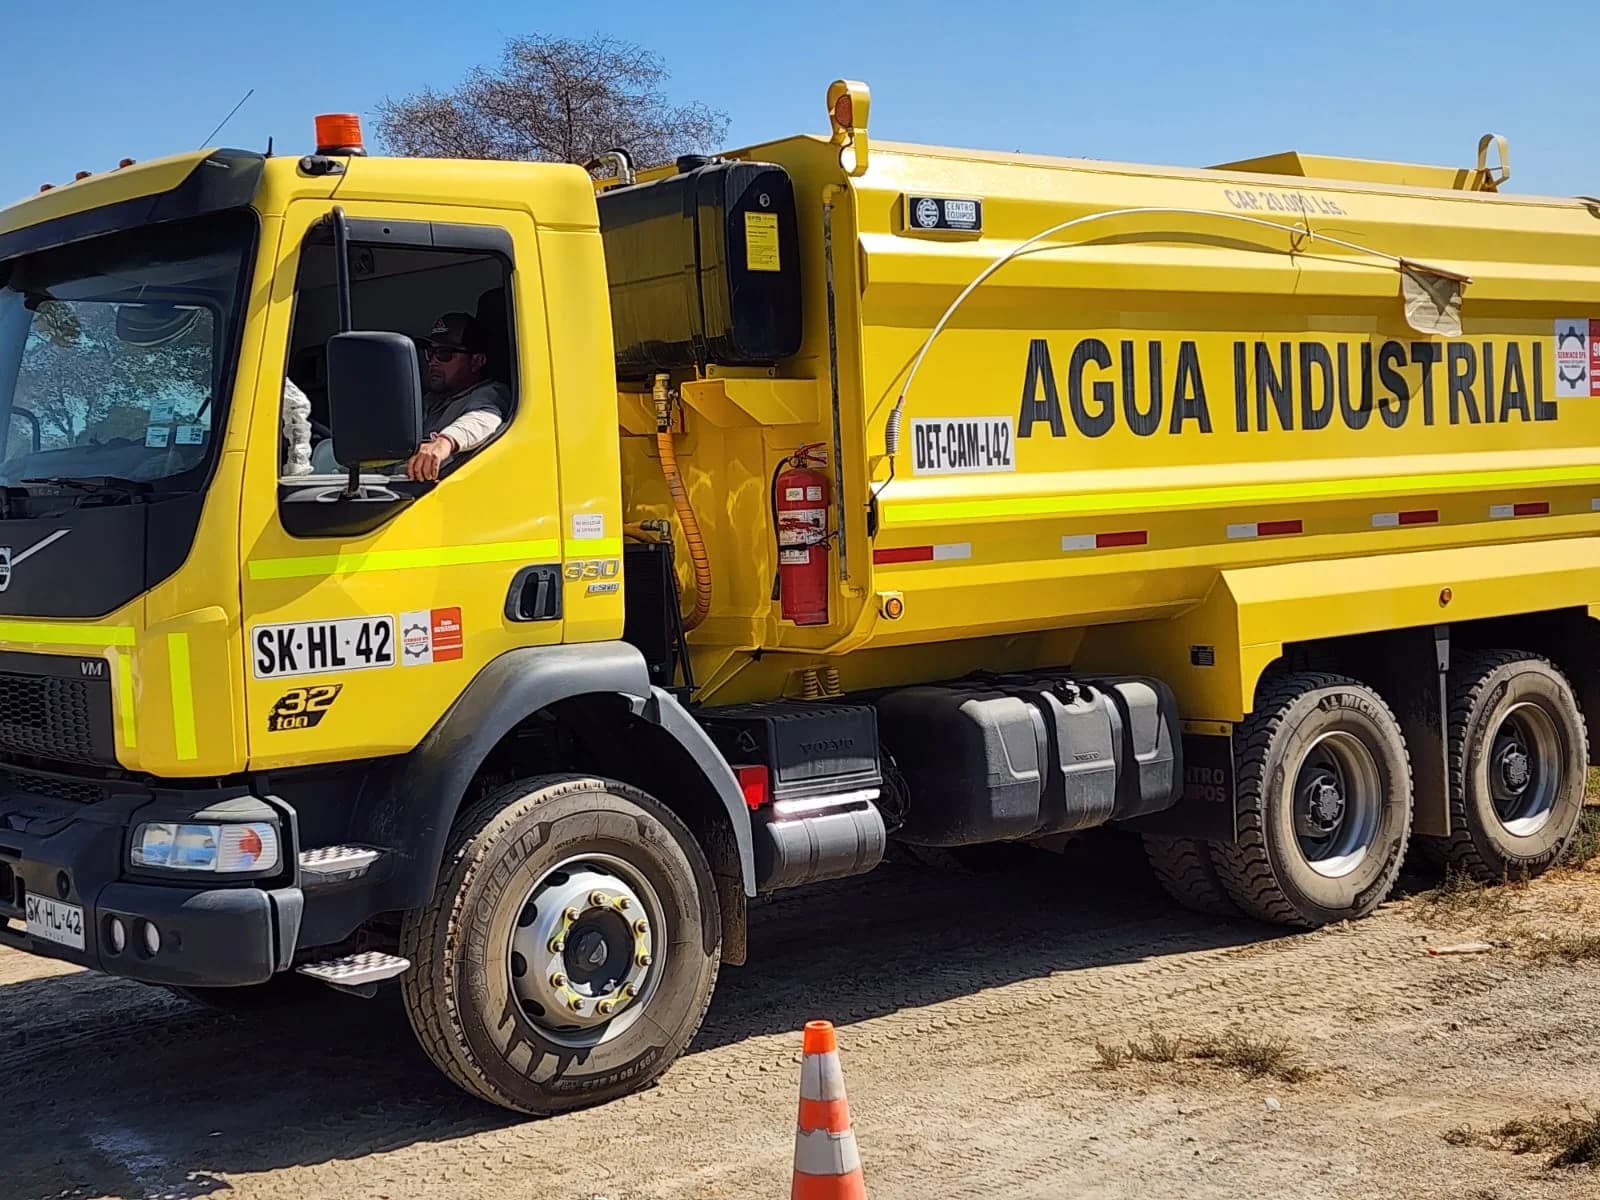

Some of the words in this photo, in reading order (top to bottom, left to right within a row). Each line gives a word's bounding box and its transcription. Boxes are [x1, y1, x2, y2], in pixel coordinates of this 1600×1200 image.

[945, 201, 975, 211] CENTRO
[1017, 338, 1213, 438] AGUA
[1233, 341, 1558, 432] INDUSTRIAL
[915, 421, 1010, 469] DET-CAM-L42
[565, 559, 620, 579] 330
[81, 662, 103, 676] VM
[277, 686, 338, 715] 32
[276, 715, 309, 730] ton
[467, 825, 543, 966] MICHELIN
